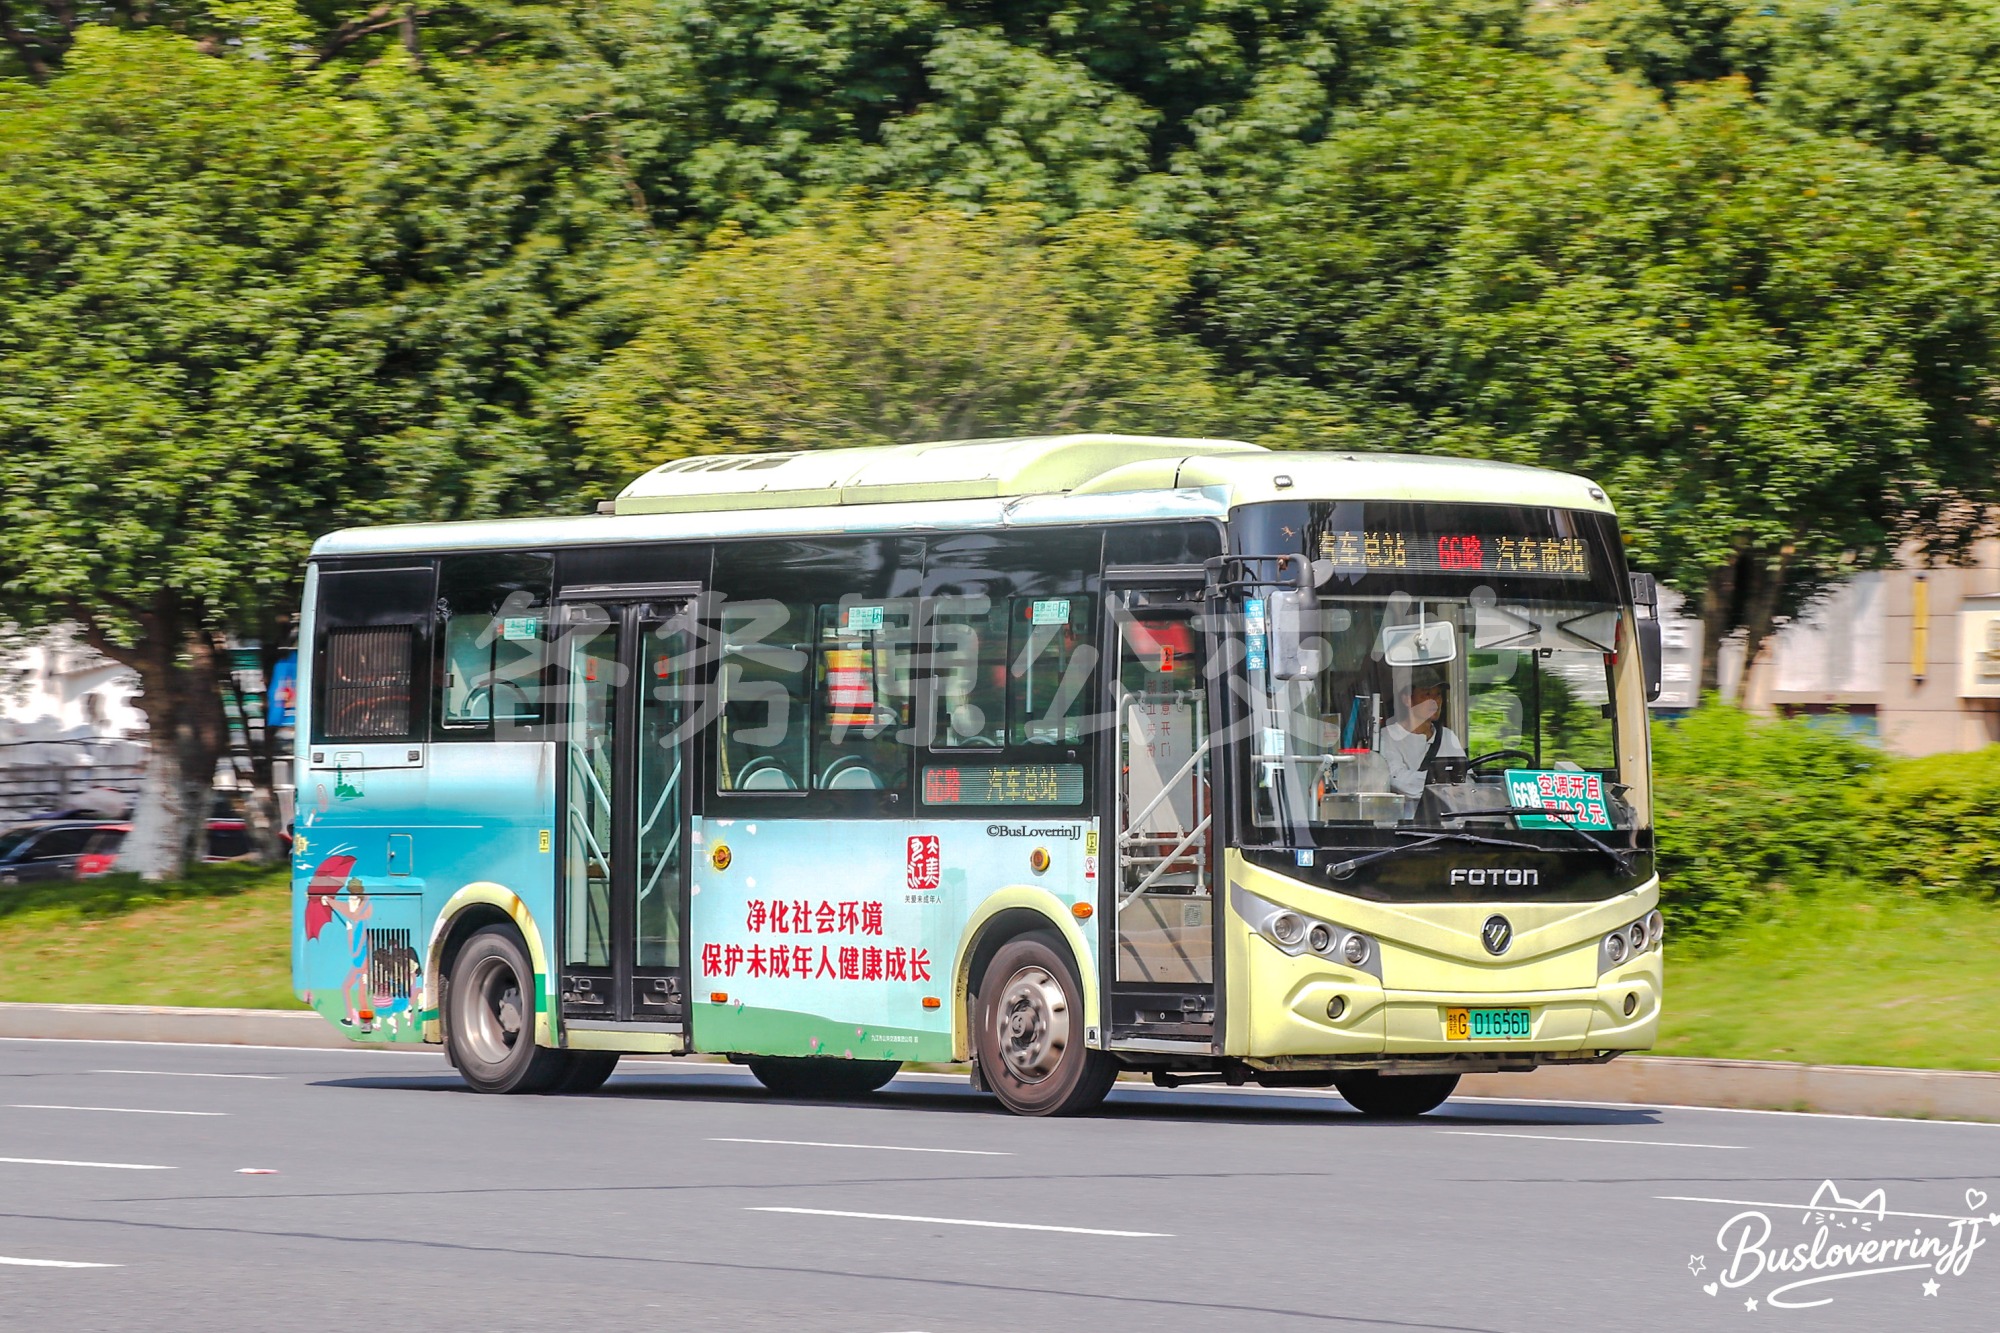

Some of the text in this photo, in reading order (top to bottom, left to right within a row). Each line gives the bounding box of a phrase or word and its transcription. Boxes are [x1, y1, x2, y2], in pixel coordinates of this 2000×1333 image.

[1319, 531, 1586, 573] 汽车总站 66路 汽车南站
[926, 766, 1057, 802] 66路 汽车总站
[1513, 781, 1542, 809] 66路
[1538, 774, 1602, 801] 空调开启
[1543, 800, 1607, 825] 票价2元
[1450, 868, 1539, 885] FOTON
[746, 900, 884, 936] 净化社会环境
[701, 942, 932, 984] 保护未成年人健康成长
